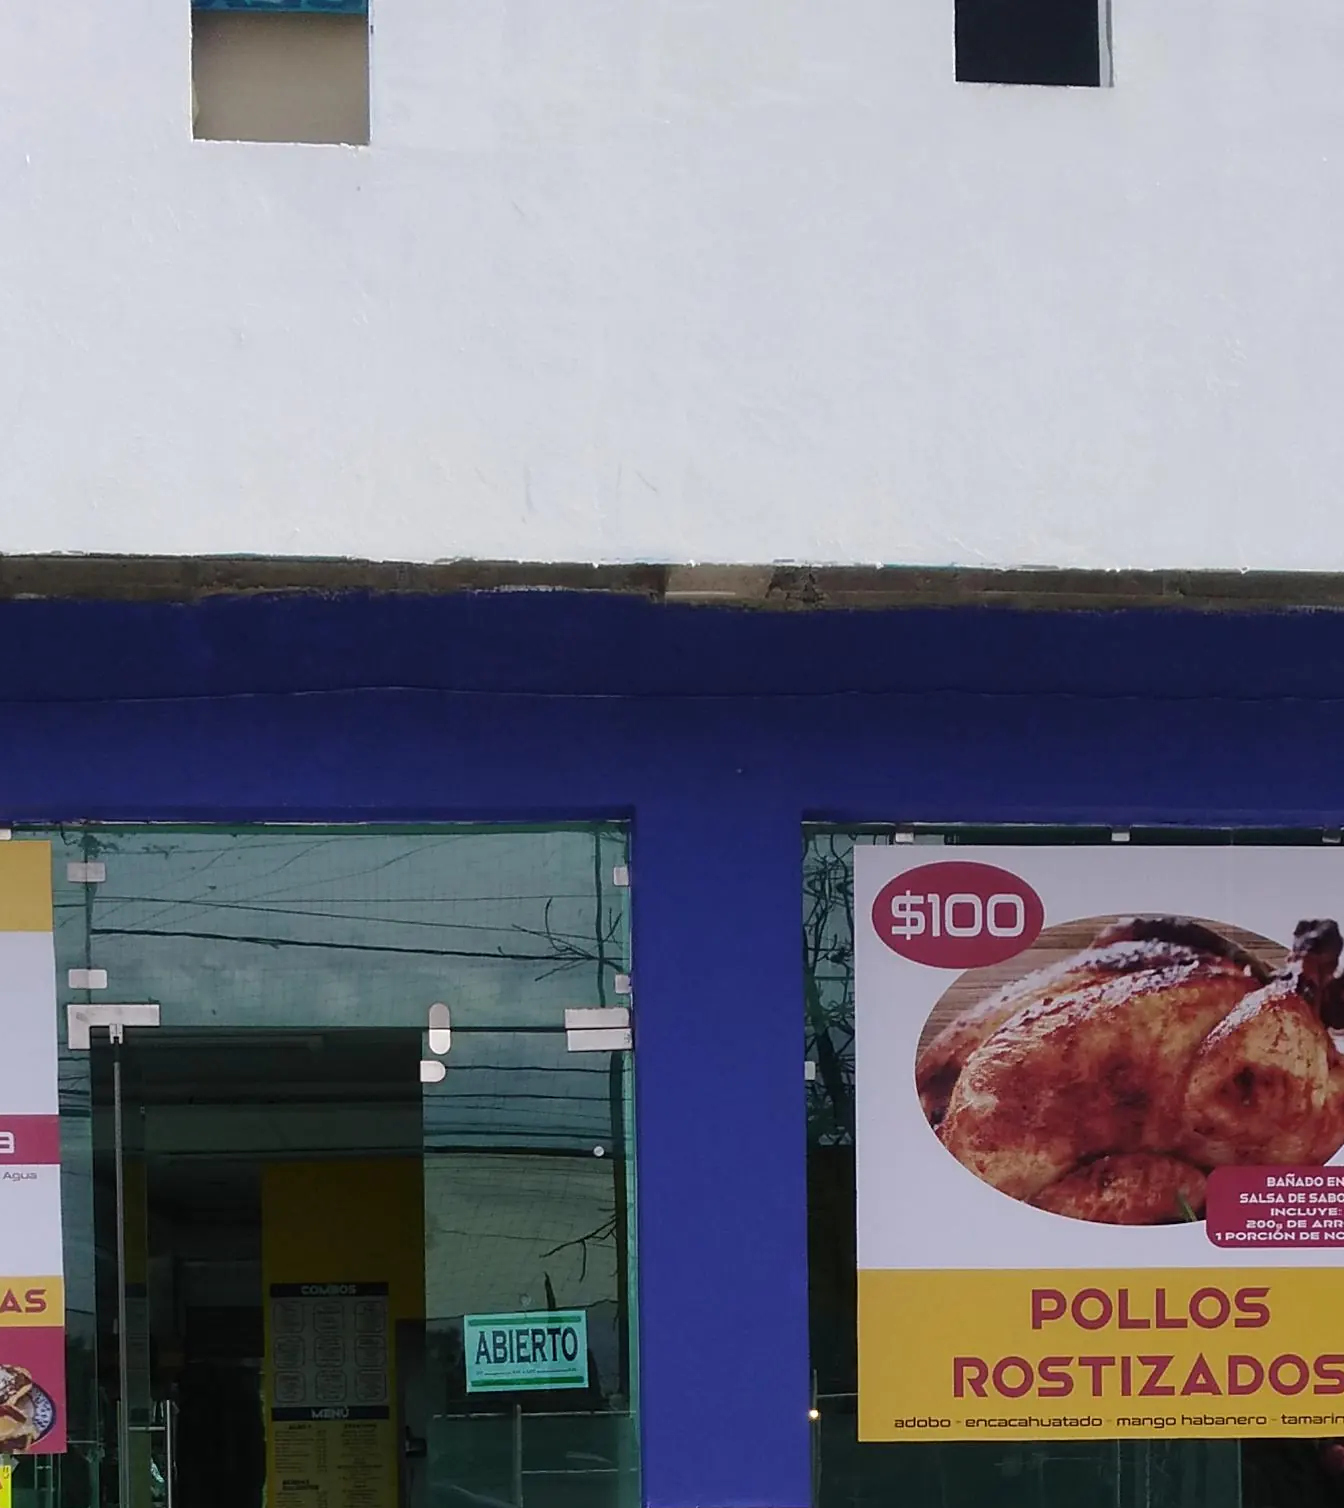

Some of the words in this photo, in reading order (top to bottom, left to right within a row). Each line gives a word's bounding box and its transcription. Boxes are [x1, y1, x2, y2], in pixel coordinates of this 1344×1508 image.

[891, 890, 1025, 941] $100
[2, 1170, 38, 1182] Agua
[1267, 1173, 1323, 1187] BAÑADO
[1240, 1193, 1285, 1204] SALSA
[1288, 1193, 1307, 1203] DE
[1287, 1220, 1307, 1228] DE
[1216, 1232, 1223, 1241] 1
[1225, 1229, 1296, 1241] PORCIÓN
[1300, 1231, 1321, 1240] DE
[1032, 1287, 1271, 1330] POLLOS
[475, 1327, 578, 1365] ABIERTO
[894, 1417, 951, 1428] adobo
[965, 1416, 1103, 1428] encacahuatado
[1116, 1416, 1176, 1429] mango
[1181, 1414, 1267, 1426] habanero
